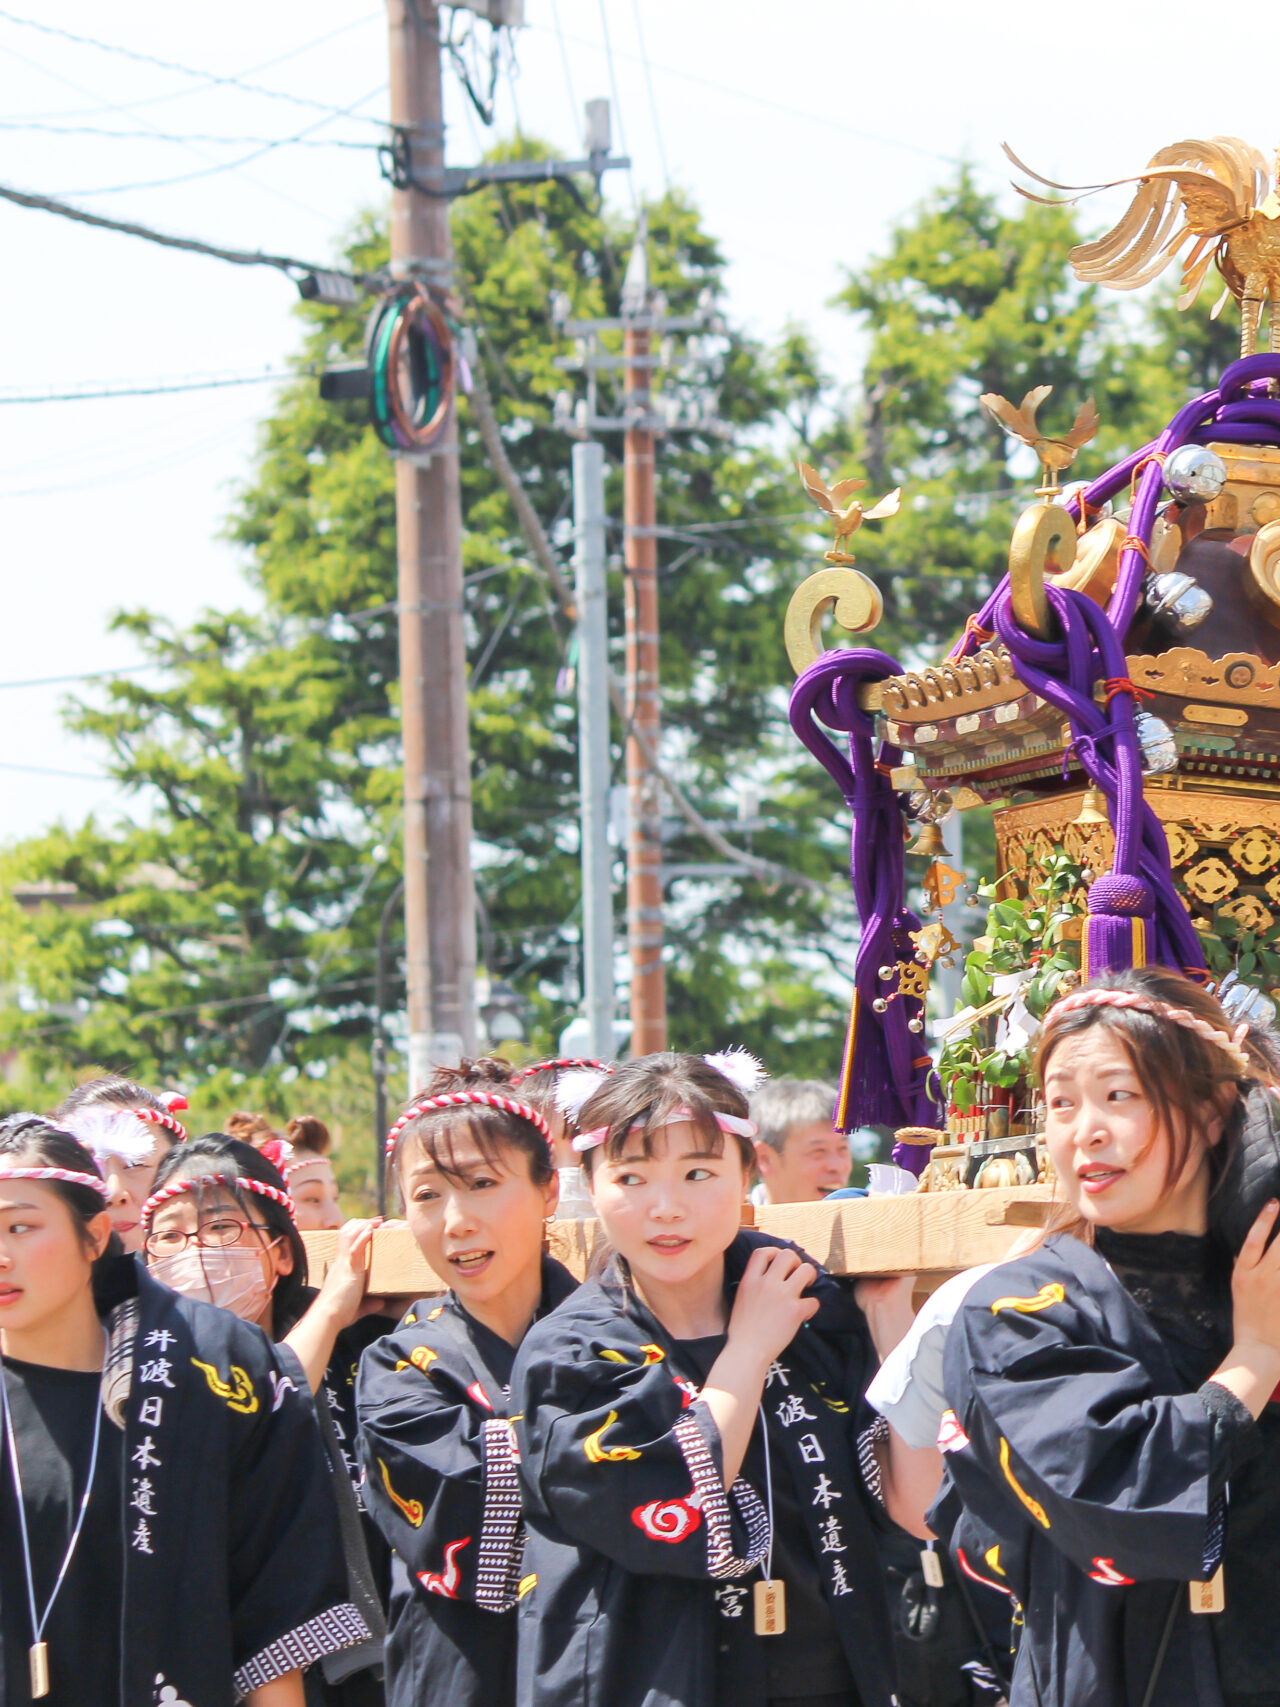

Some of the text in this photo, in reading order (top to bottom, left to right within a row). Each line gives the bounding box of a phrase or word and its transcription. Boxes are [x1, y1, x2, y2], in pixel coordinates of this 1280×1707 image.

[130, 1329, 178, 1554] 井波日本遺産
[765, 1360, 853, 1597] 井波日本遺産
[715, 1584, 749, 1617] 宮
